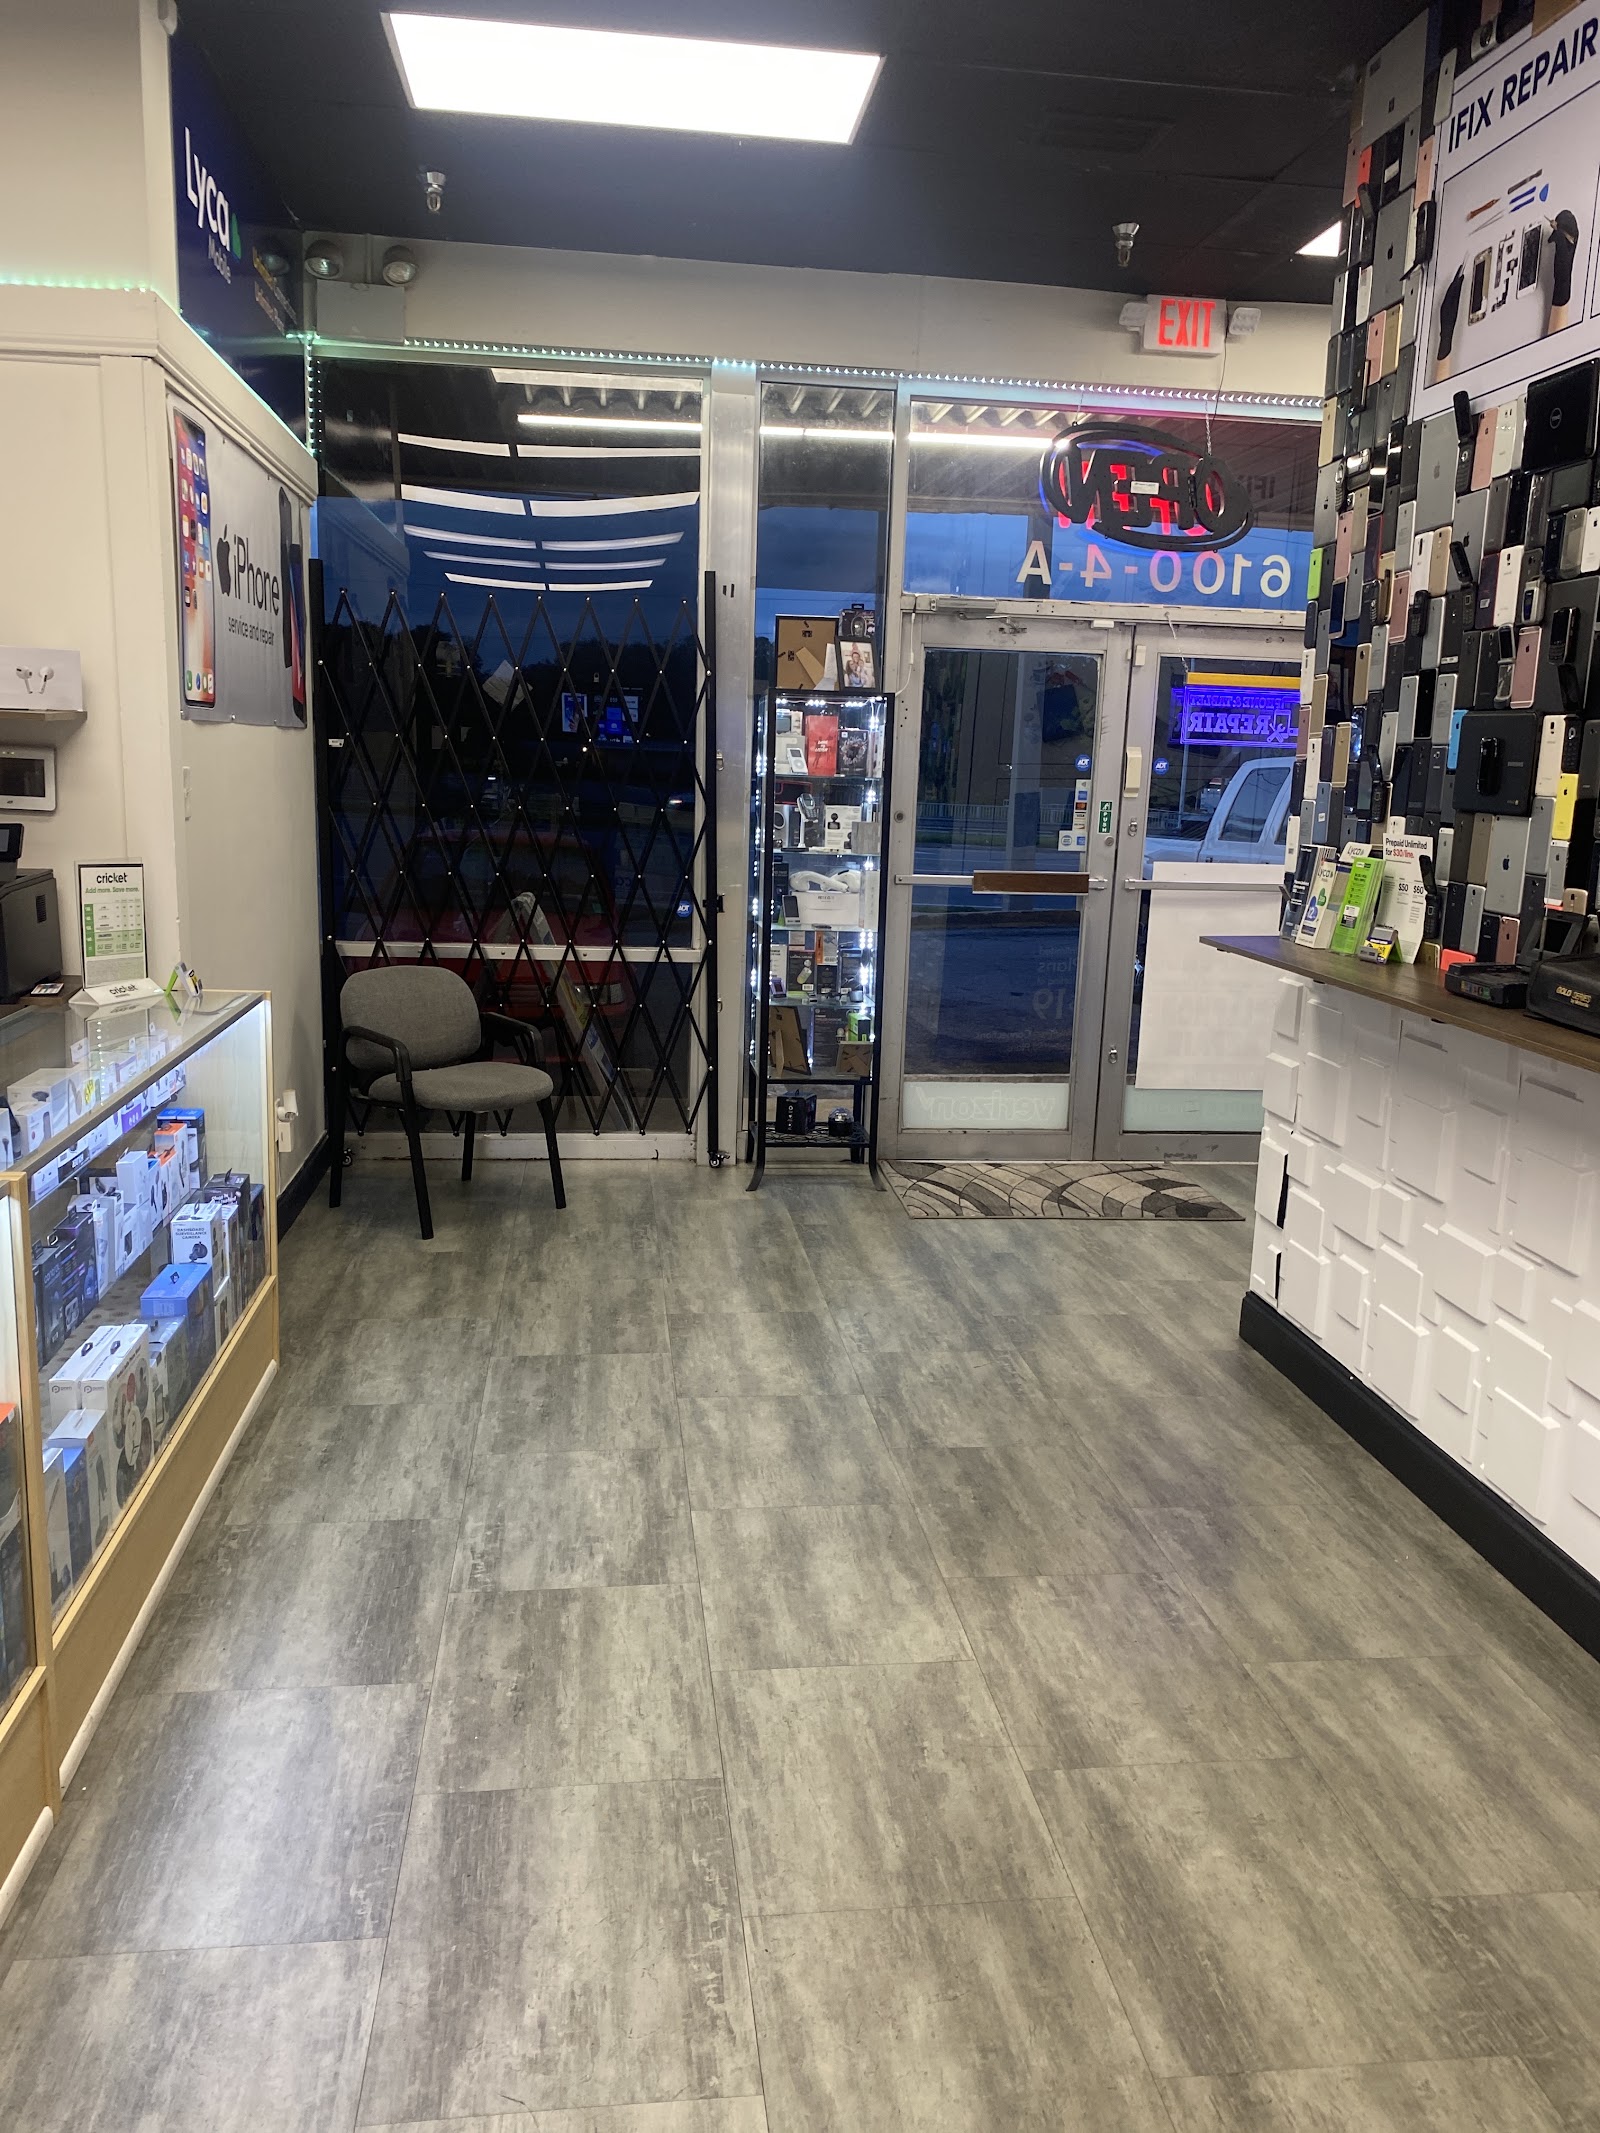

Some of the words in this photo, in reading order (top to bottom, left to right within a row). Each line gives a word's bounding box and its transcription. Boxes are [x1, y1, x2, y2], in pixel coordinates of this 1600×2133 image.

[1448, 87, 1495, 154] IFIX
[1500, 16, 1600, 119] REPAIR
[184, 126, 231, 252] Lyca
[208, 234, 232, 285] Mobile
[1158, 297, 1217, 348] EXIT
[233, 533, 280, 616] iPhone
[228, 615, 249, 638] service
[249, 621, 260, 642] and
[260, 625, 275, 647] repair
[1077, 758, 1090, 766] ADT
[1155, 762, 1168, 770] ADT
[1101, 811, 1109, 833] PUSH
[1385, 838, 1404, 848] Prepaid
[1404, 840, 1428, 850] Unlimited
[1385, 848, 1393, 856] for
[96, 872, 129, 884] cricket
[1398, 883, 1409, 892] $50
[677, 904, 690, 912] ADT
[109, 984, 139, 995] cricket
